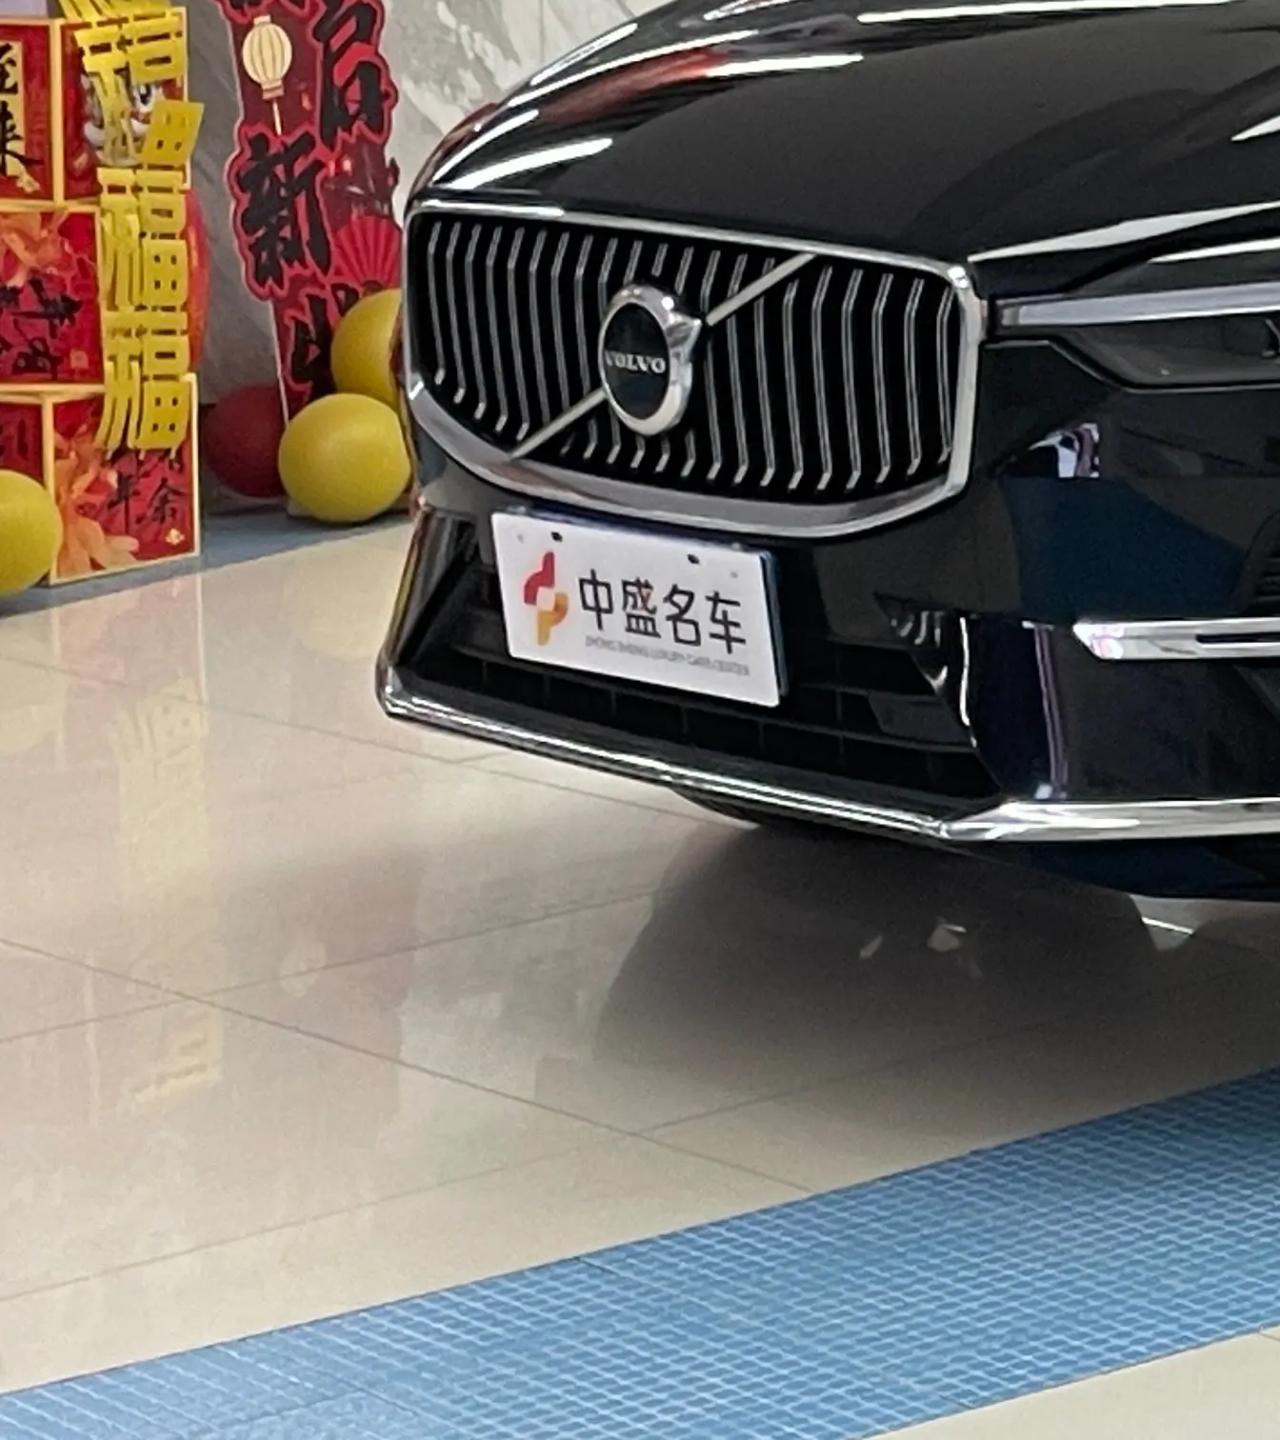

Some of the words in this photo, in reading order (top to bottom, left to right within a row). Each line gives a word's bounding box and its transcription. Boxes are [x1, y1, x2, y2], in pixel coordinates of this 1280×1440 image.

[603, 349, 667, 374] VOLVO
[578, 568, 746, 655] 中盛名车
